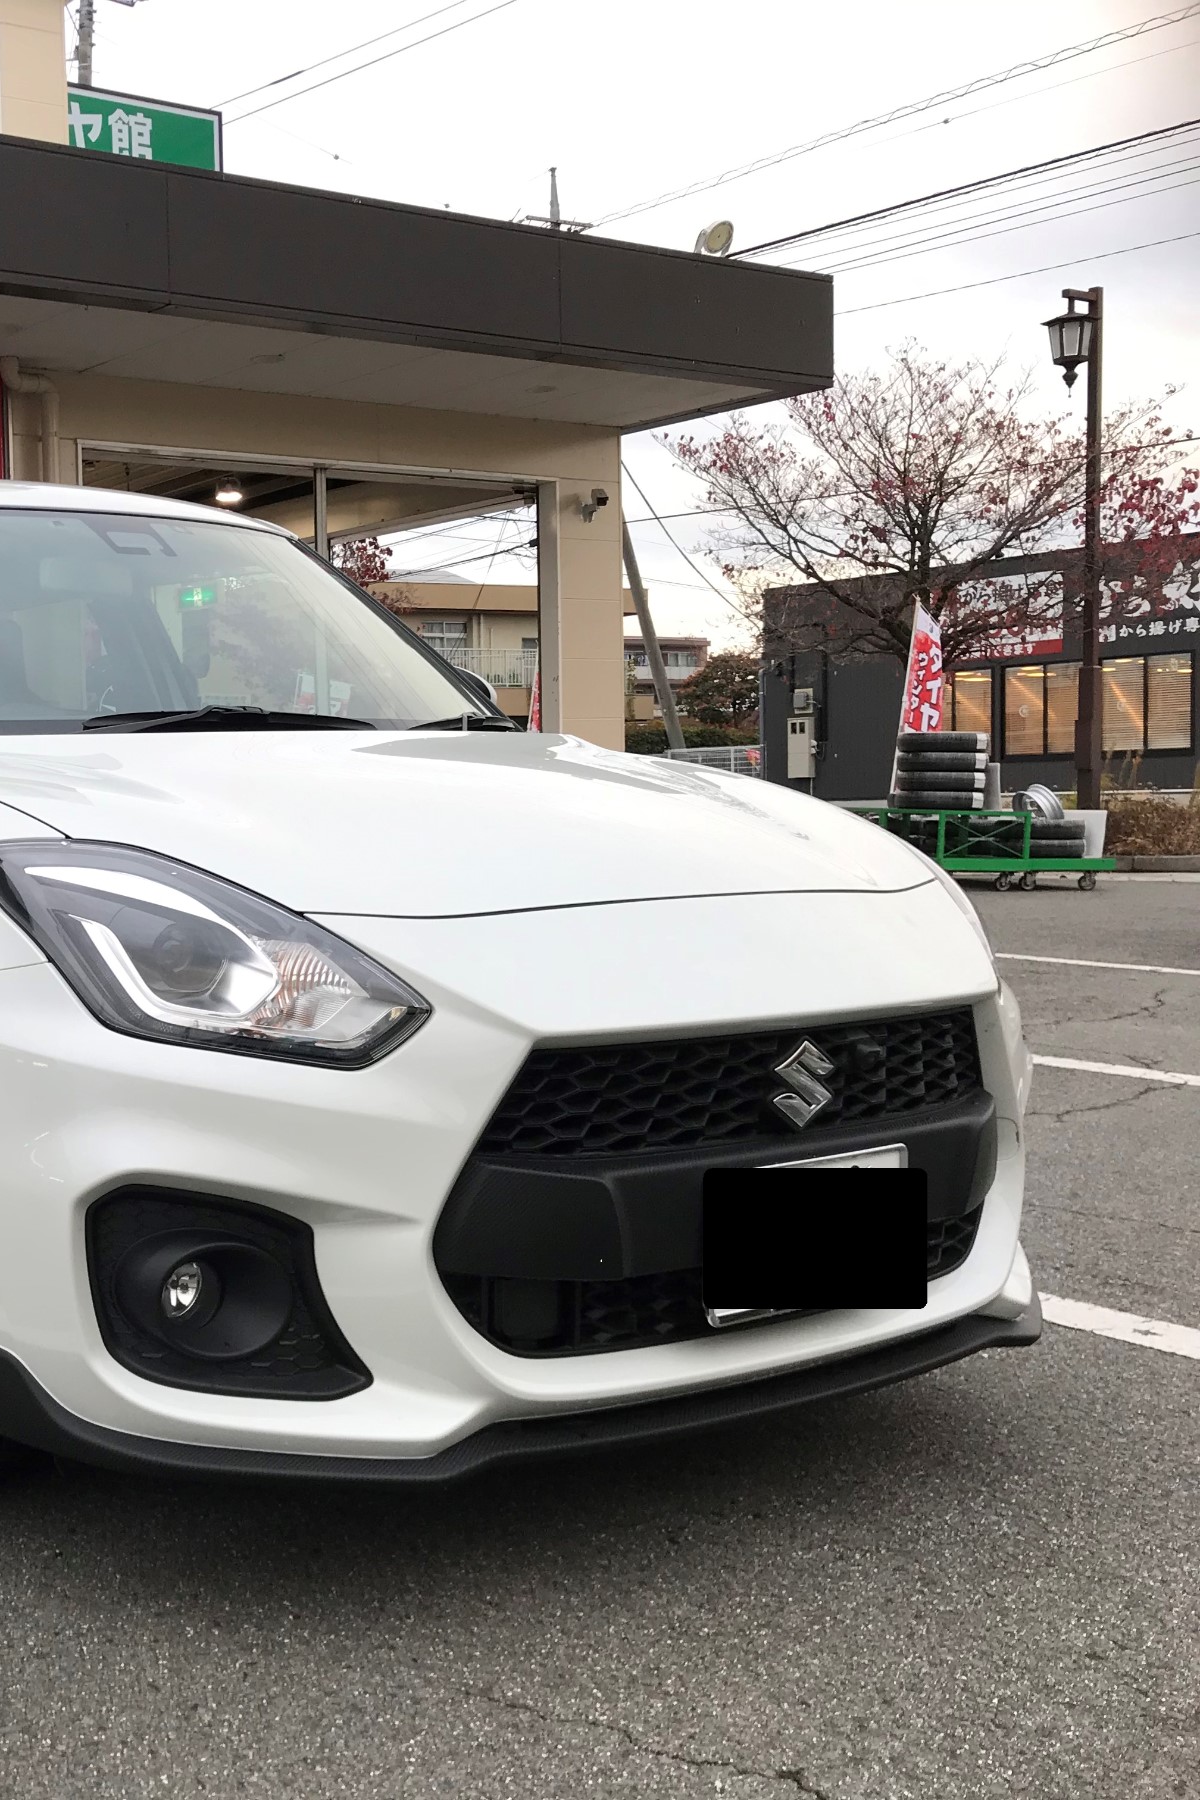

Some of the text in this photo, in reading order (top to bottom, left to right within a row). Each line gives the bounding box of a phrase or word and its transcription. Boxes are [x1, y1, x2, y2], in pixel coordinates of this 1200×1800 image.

[909, 651, 929, 723] ウィンター
[921, 643, 943, 732] タイヤ
